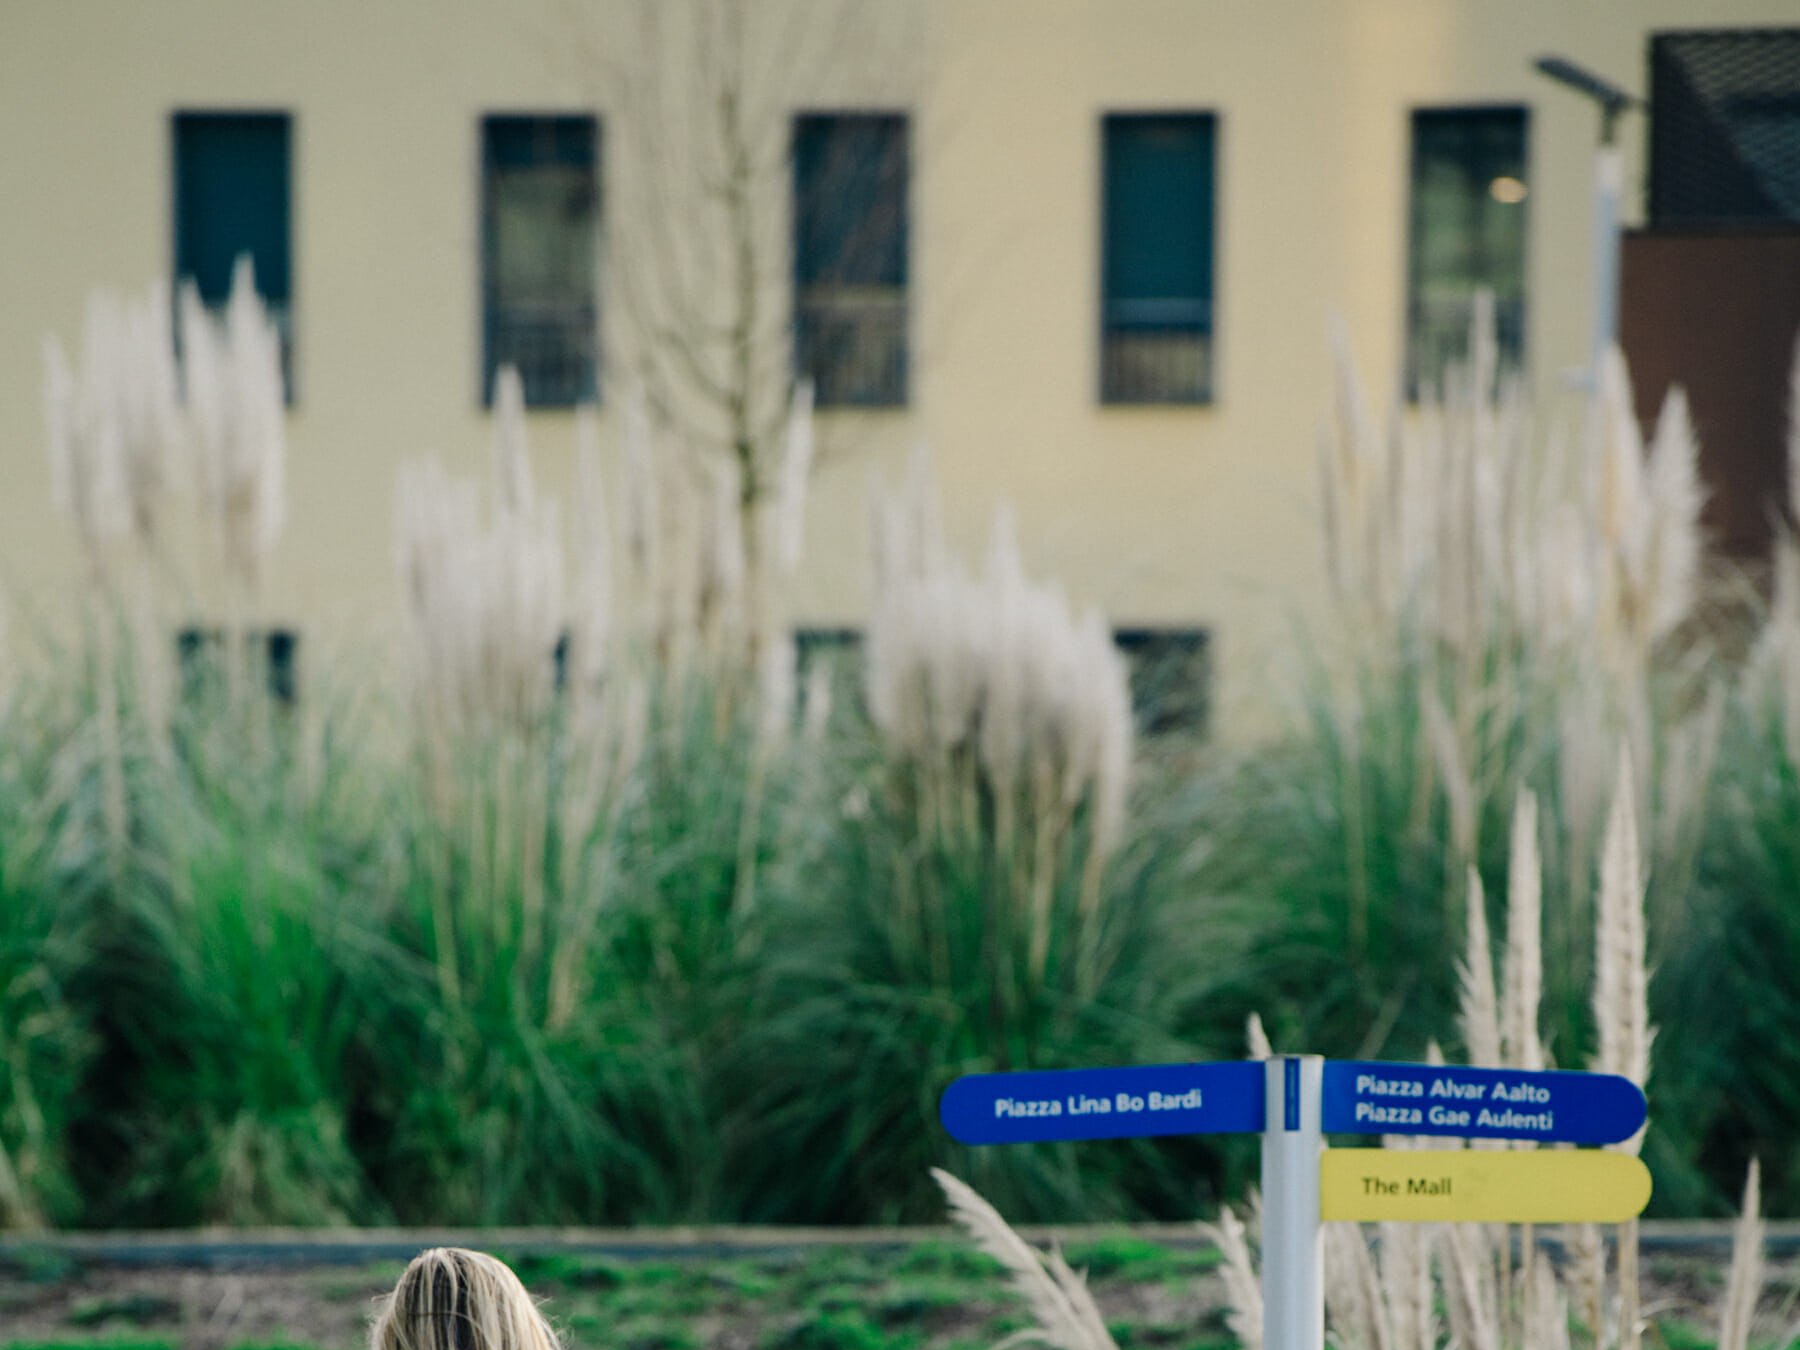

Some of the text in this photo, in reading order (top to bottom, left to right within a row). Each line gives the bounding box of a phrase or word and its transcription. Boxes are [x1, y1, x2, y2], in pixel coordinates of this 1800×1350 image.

[994, 1088, 1202, 1118] Piazza Lina Bo Bardi
[1356, 1075, 1551, 1103] Piazza Alvar Aalto
[1355, 1102, 1554, 1130] Piazza Gae Aulenti
[1362, 1176, 1452, 1195] The Mall
